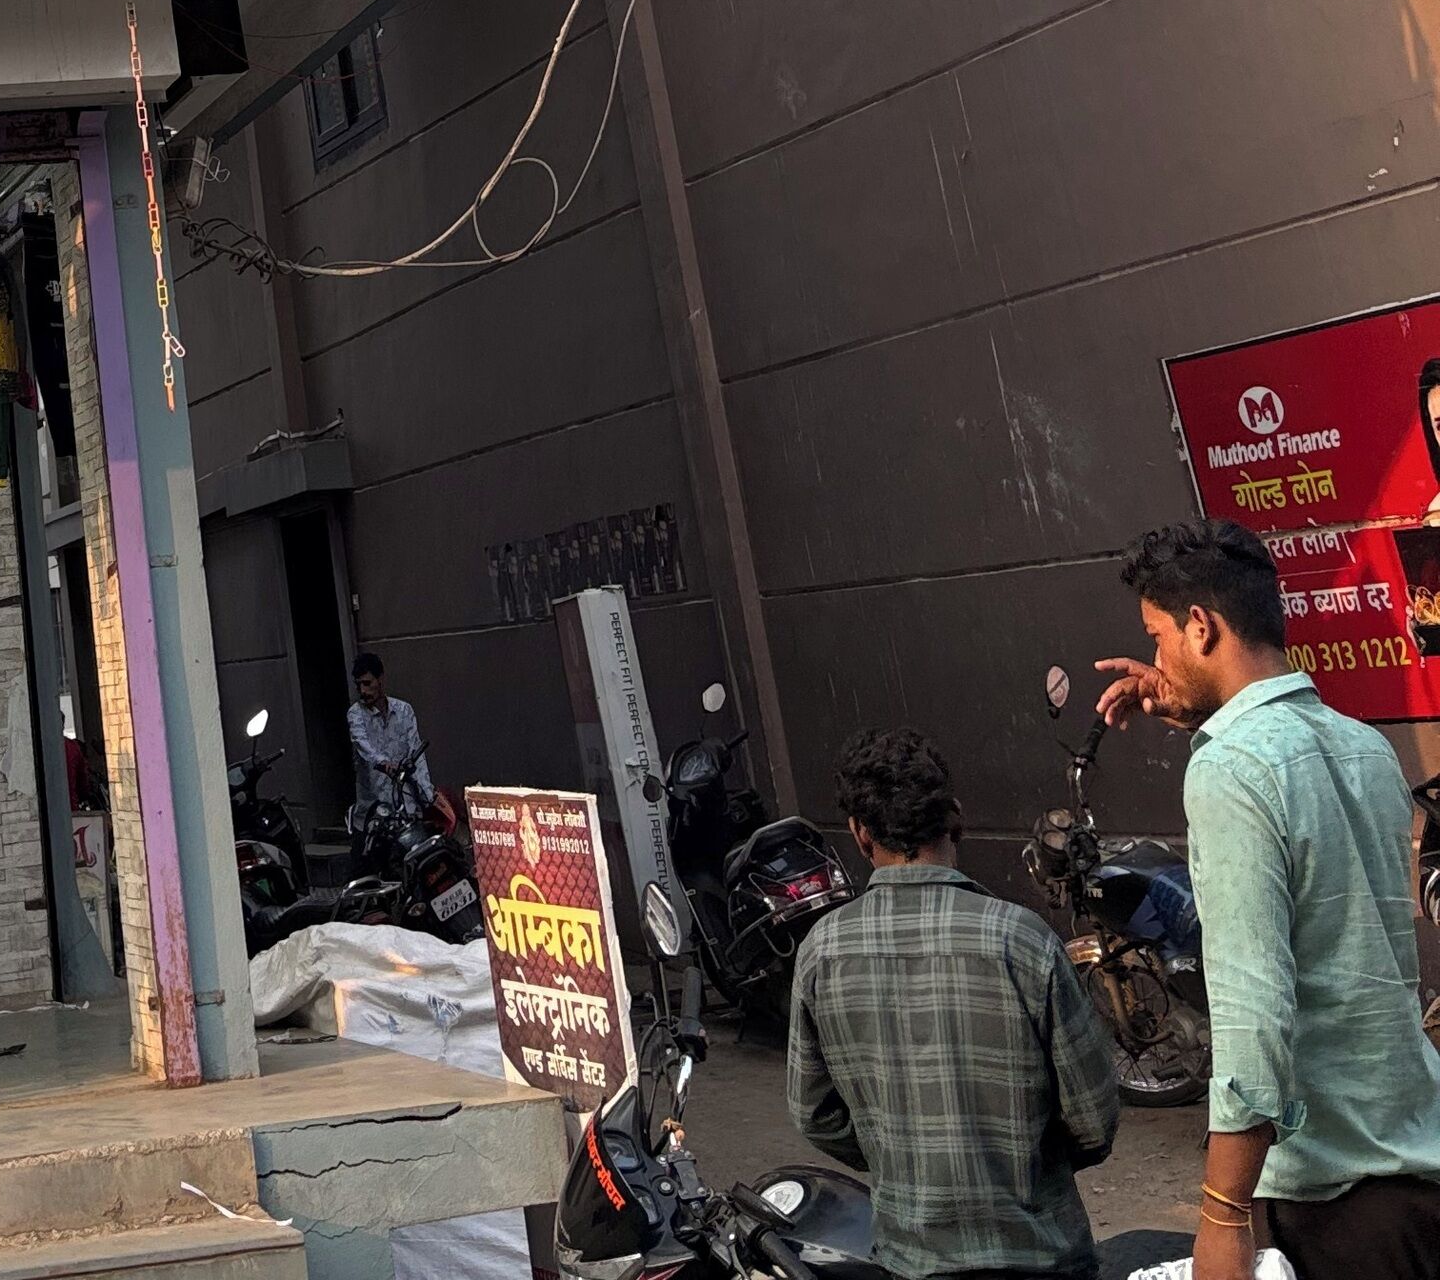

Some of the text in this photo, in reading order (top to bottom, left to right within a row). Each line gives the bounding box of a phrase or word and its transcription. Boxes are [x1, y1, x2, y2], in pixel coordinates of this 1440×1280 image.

[1207, 427, 1341, 470] Muthoot Finance
[1231, 459, 1338, 513] गोल्ड लोन
[1310, 585, 1362, 615] ब्याज
[1362, 582, 1394, 612] दर
[610, 611, 629, 664] PERFECT
[1318, 640, 1357, 672] 313
[1360, 635, 1412, 669] 1212
[622, 667, 633, 686] FIT
[626, 693, 646, 749] PERFECT
[486, 873, 606, 973] अम्बिका
[521, 1042, 607, 1088] एण्ड सर्विस सेंटर
